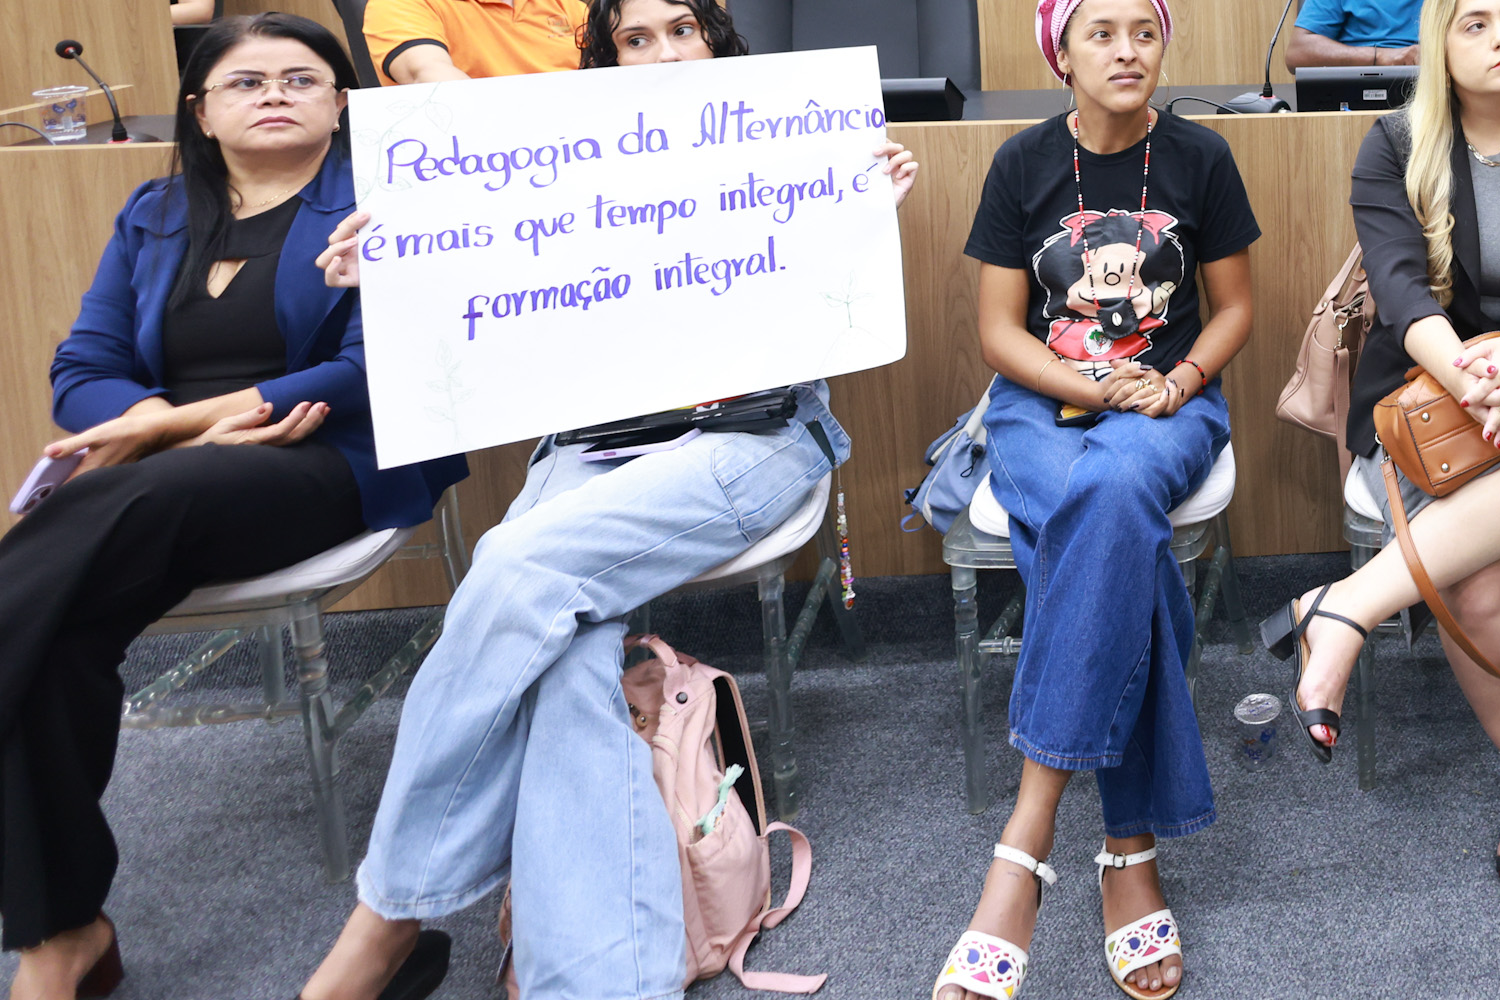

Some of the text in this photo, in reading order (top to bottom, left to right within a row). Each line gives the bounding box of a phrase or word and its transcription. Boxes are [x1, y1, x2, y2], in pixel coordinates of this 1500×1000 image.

[386, 99, 886, 191] Pedagogia da Alternância
[362, 162, 879, 262] é mais que tempo integral, é
[462, 235, 787, 341] formação integral.
